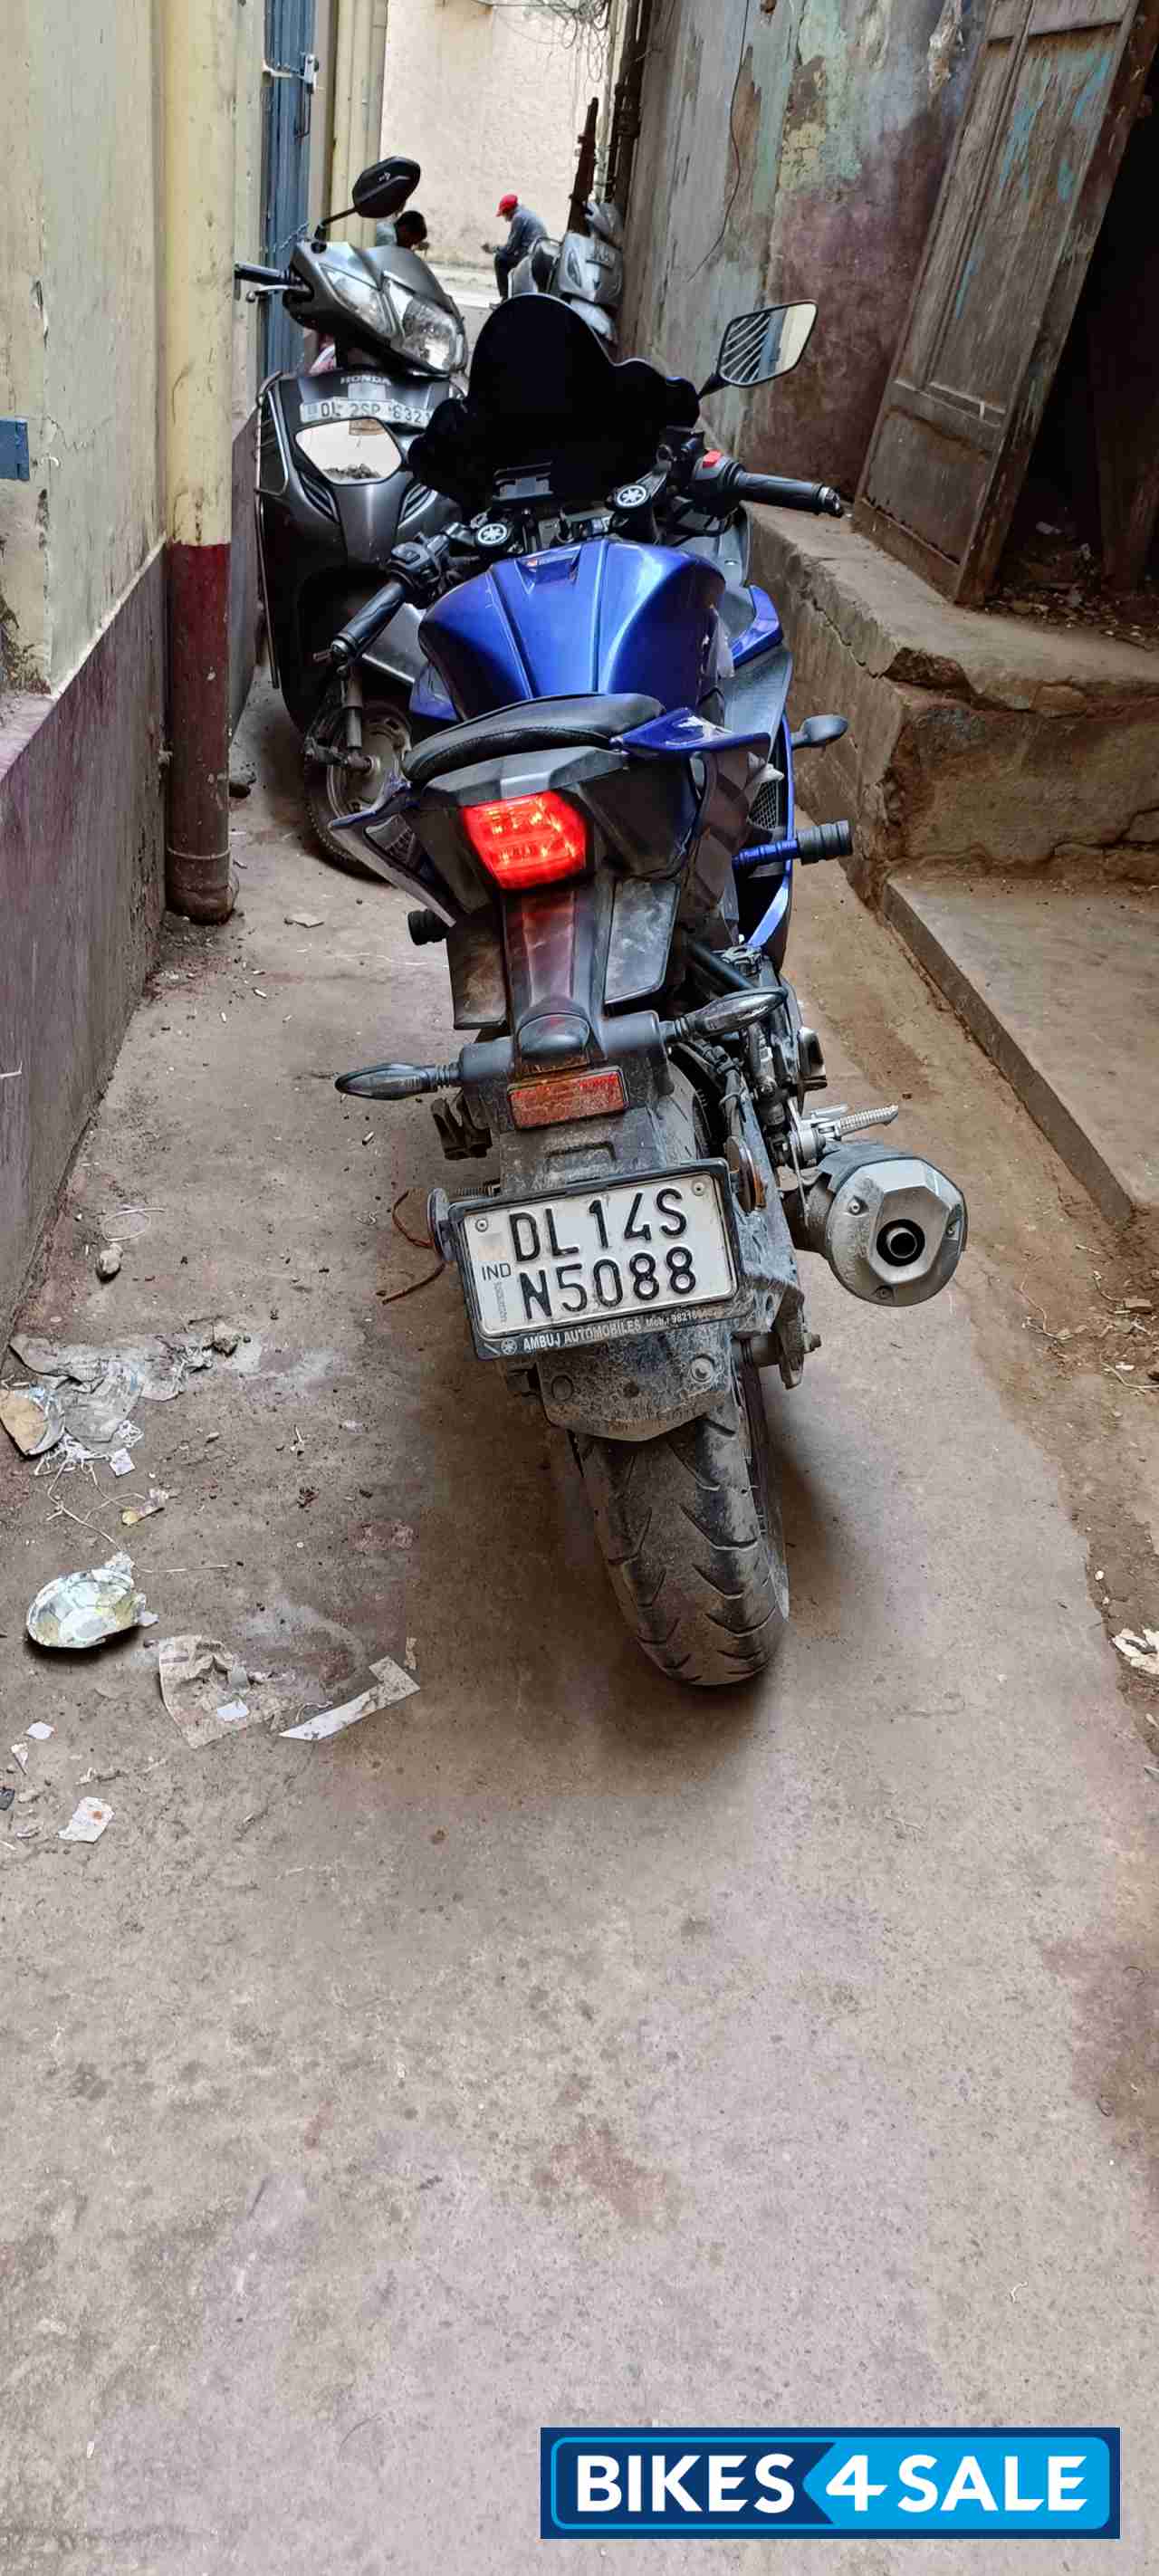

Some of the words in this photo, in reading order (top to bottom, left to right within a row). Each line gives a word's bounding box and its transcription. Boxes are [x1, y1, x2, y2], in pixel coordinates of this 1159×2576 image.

[340, 375, 391, 385] HONDA
[482, 1262, 512, 1280] IND
[519, 1246, 696, 1320] N5088
[523, 1333, 561, 1351] AMBUJ
[564, 1319, 641, 1345] AUTOMOBILES
